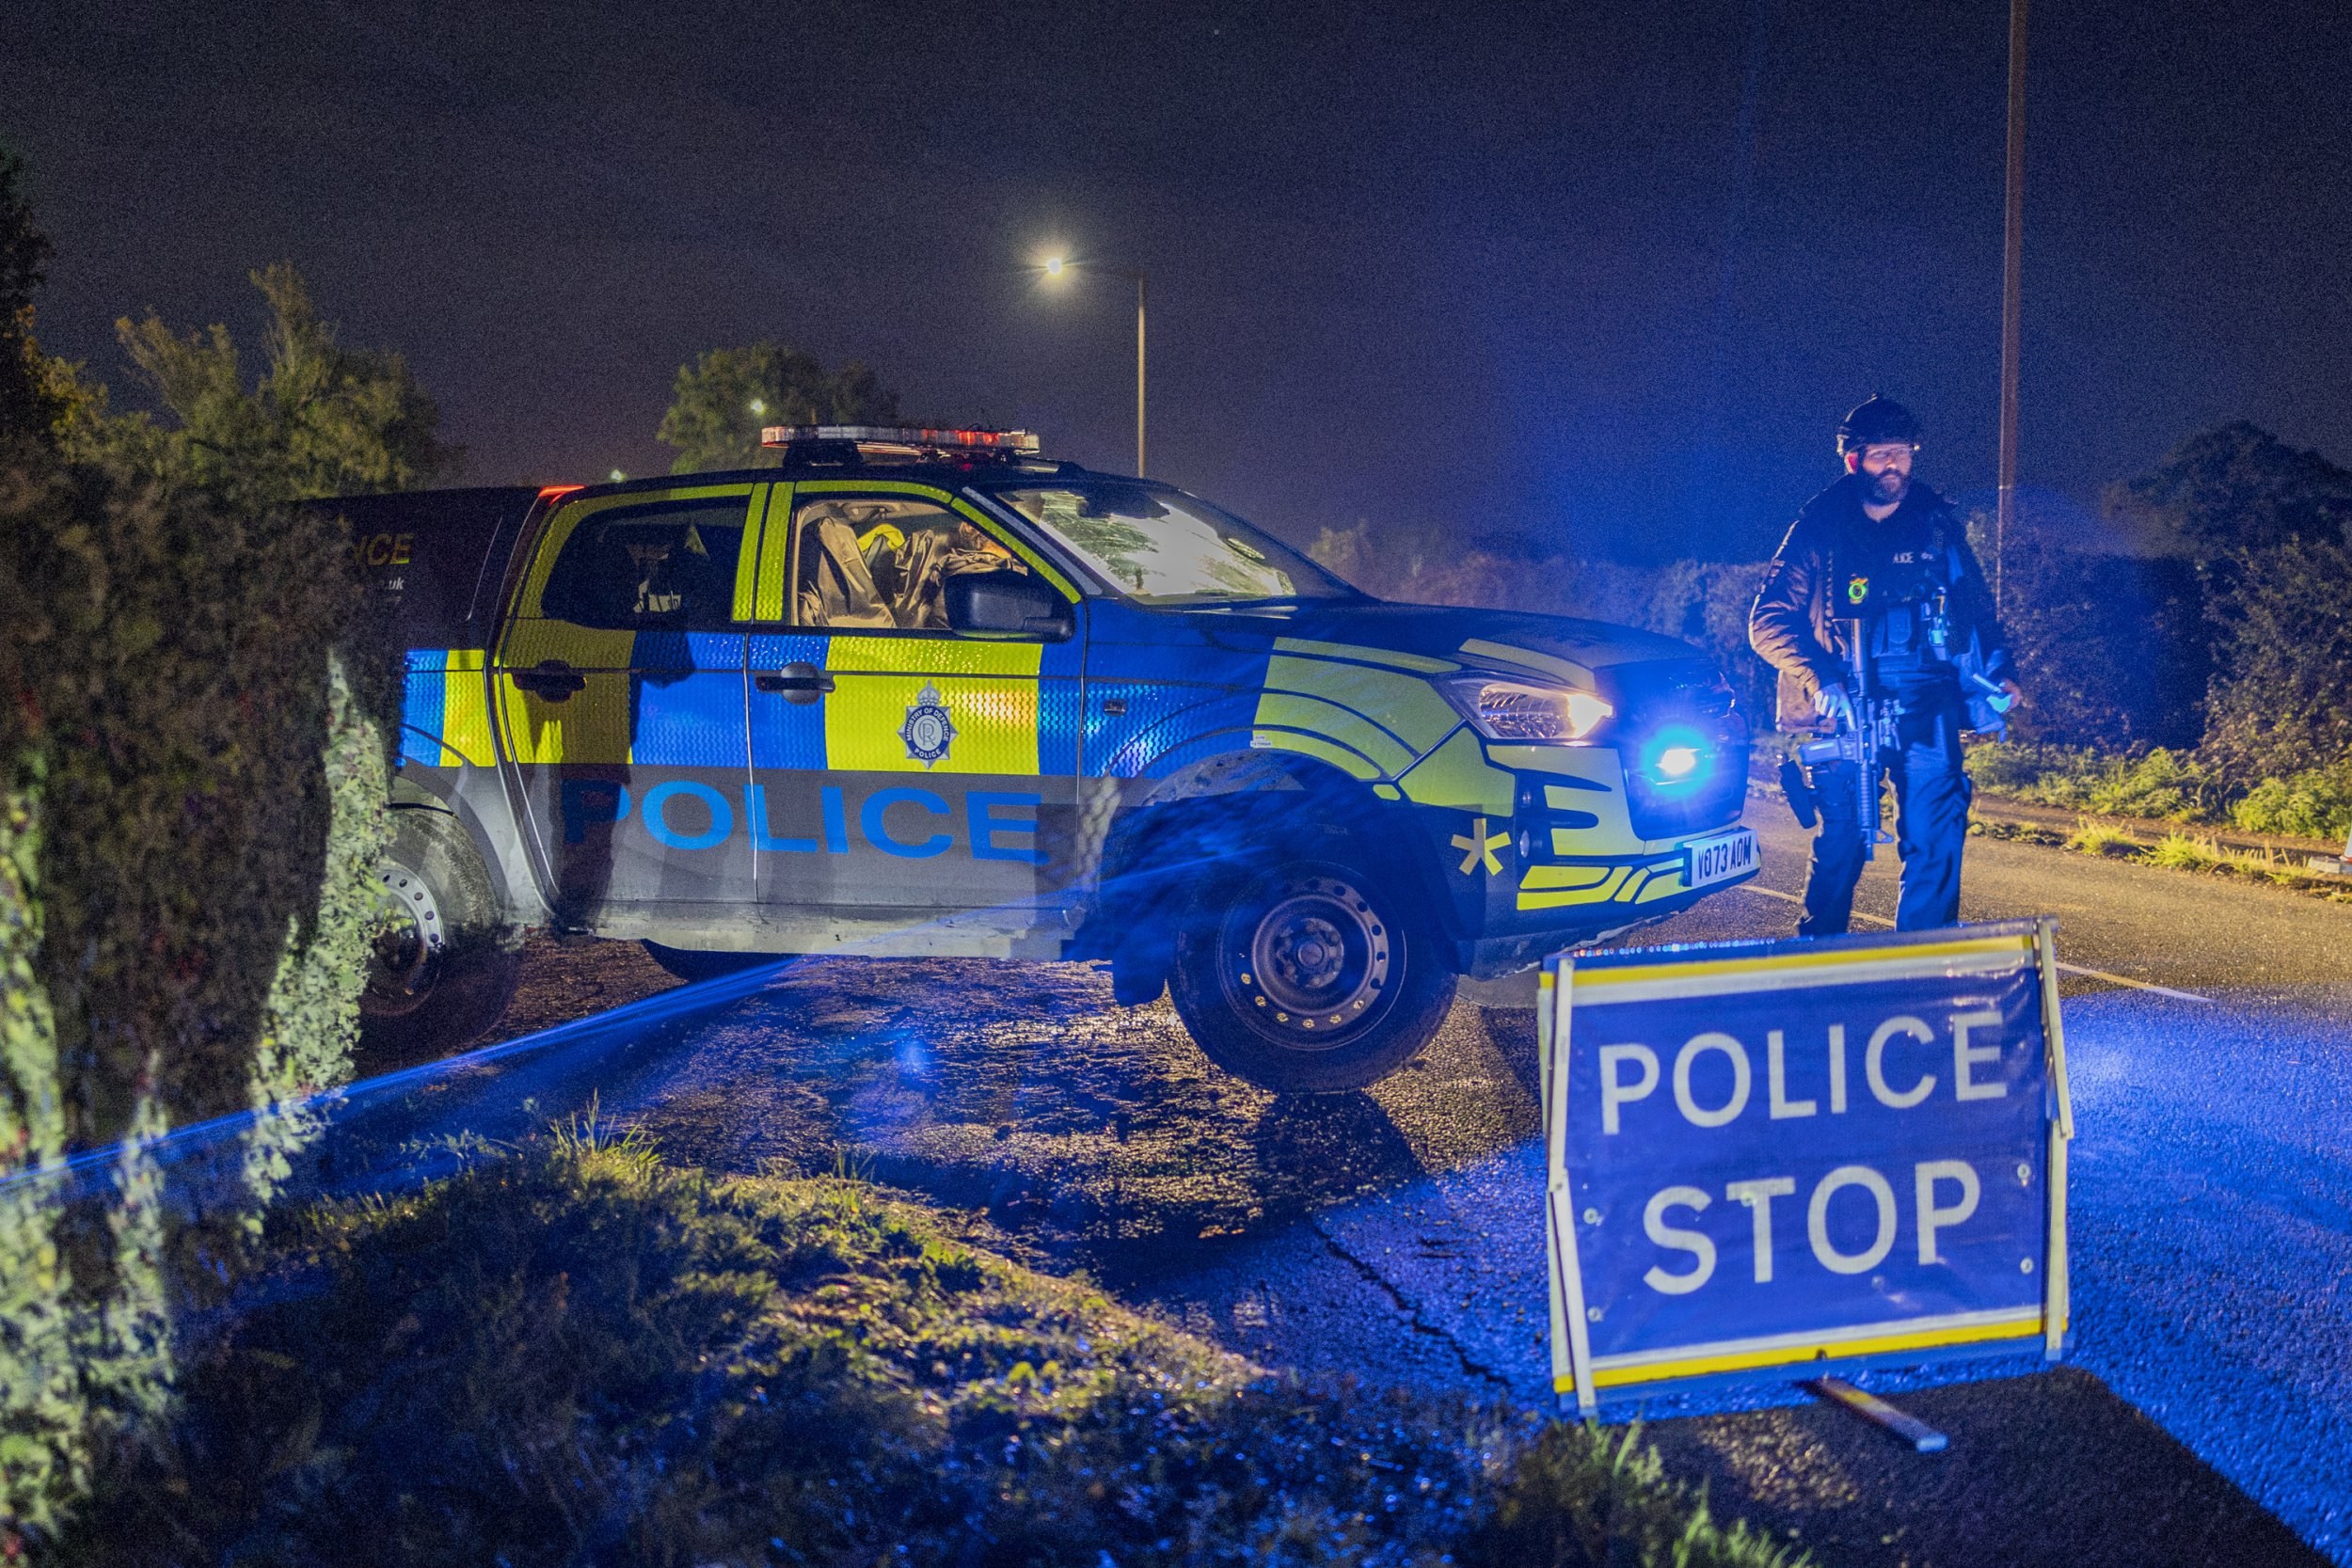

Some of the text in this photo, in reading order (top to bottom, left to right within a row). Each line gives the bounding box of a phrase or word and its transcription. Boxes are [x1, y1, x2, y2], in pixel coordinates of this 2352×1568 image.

[906, 709, 923, 741] MINISTRY
[933, 709, 949, 741] DEFENCE
[914, 748, 942, 759] POLICE
[562, 779, 1051, 866] POLICE
[1698, 835, 1752, 880] VO73 AOM
[1599, 1010, 2008, 1135] POLICE
[1643, 1159, 1980, 1295] STOP
